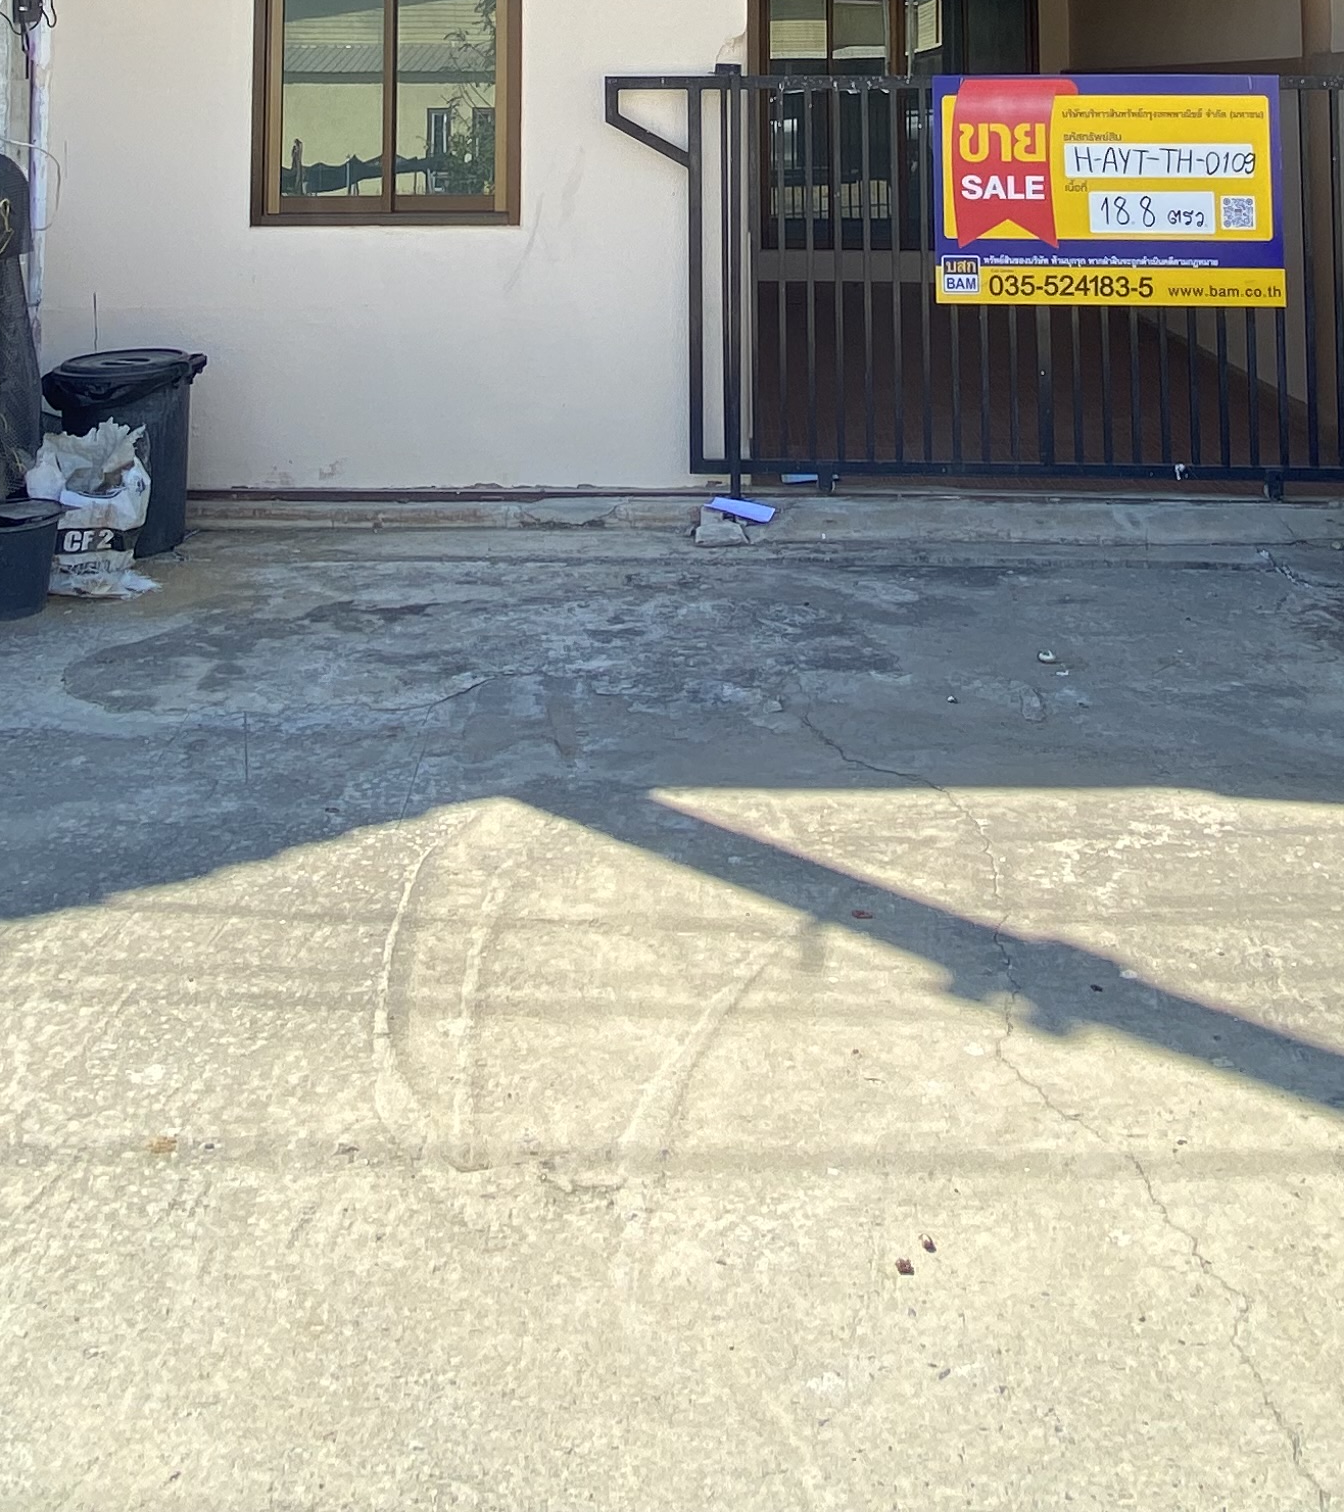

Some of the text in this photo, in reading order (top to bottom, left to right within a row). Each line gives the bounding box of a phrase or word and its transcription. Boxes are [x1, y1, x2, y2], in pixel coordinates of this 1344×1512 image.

[959, 122, 1046, 163] ขาย
[1074, 146, 1256, 176] H-AYT-TH-0109
[961, 175, 1046, 200] SALE
[945, 259, 977, 273] บสก
[946, 277, 977, 290] BAM
[989, 274, 1282, 298] 035-524183-5 www.bam.co.th
[63, 529, 115, 552] CF 2
